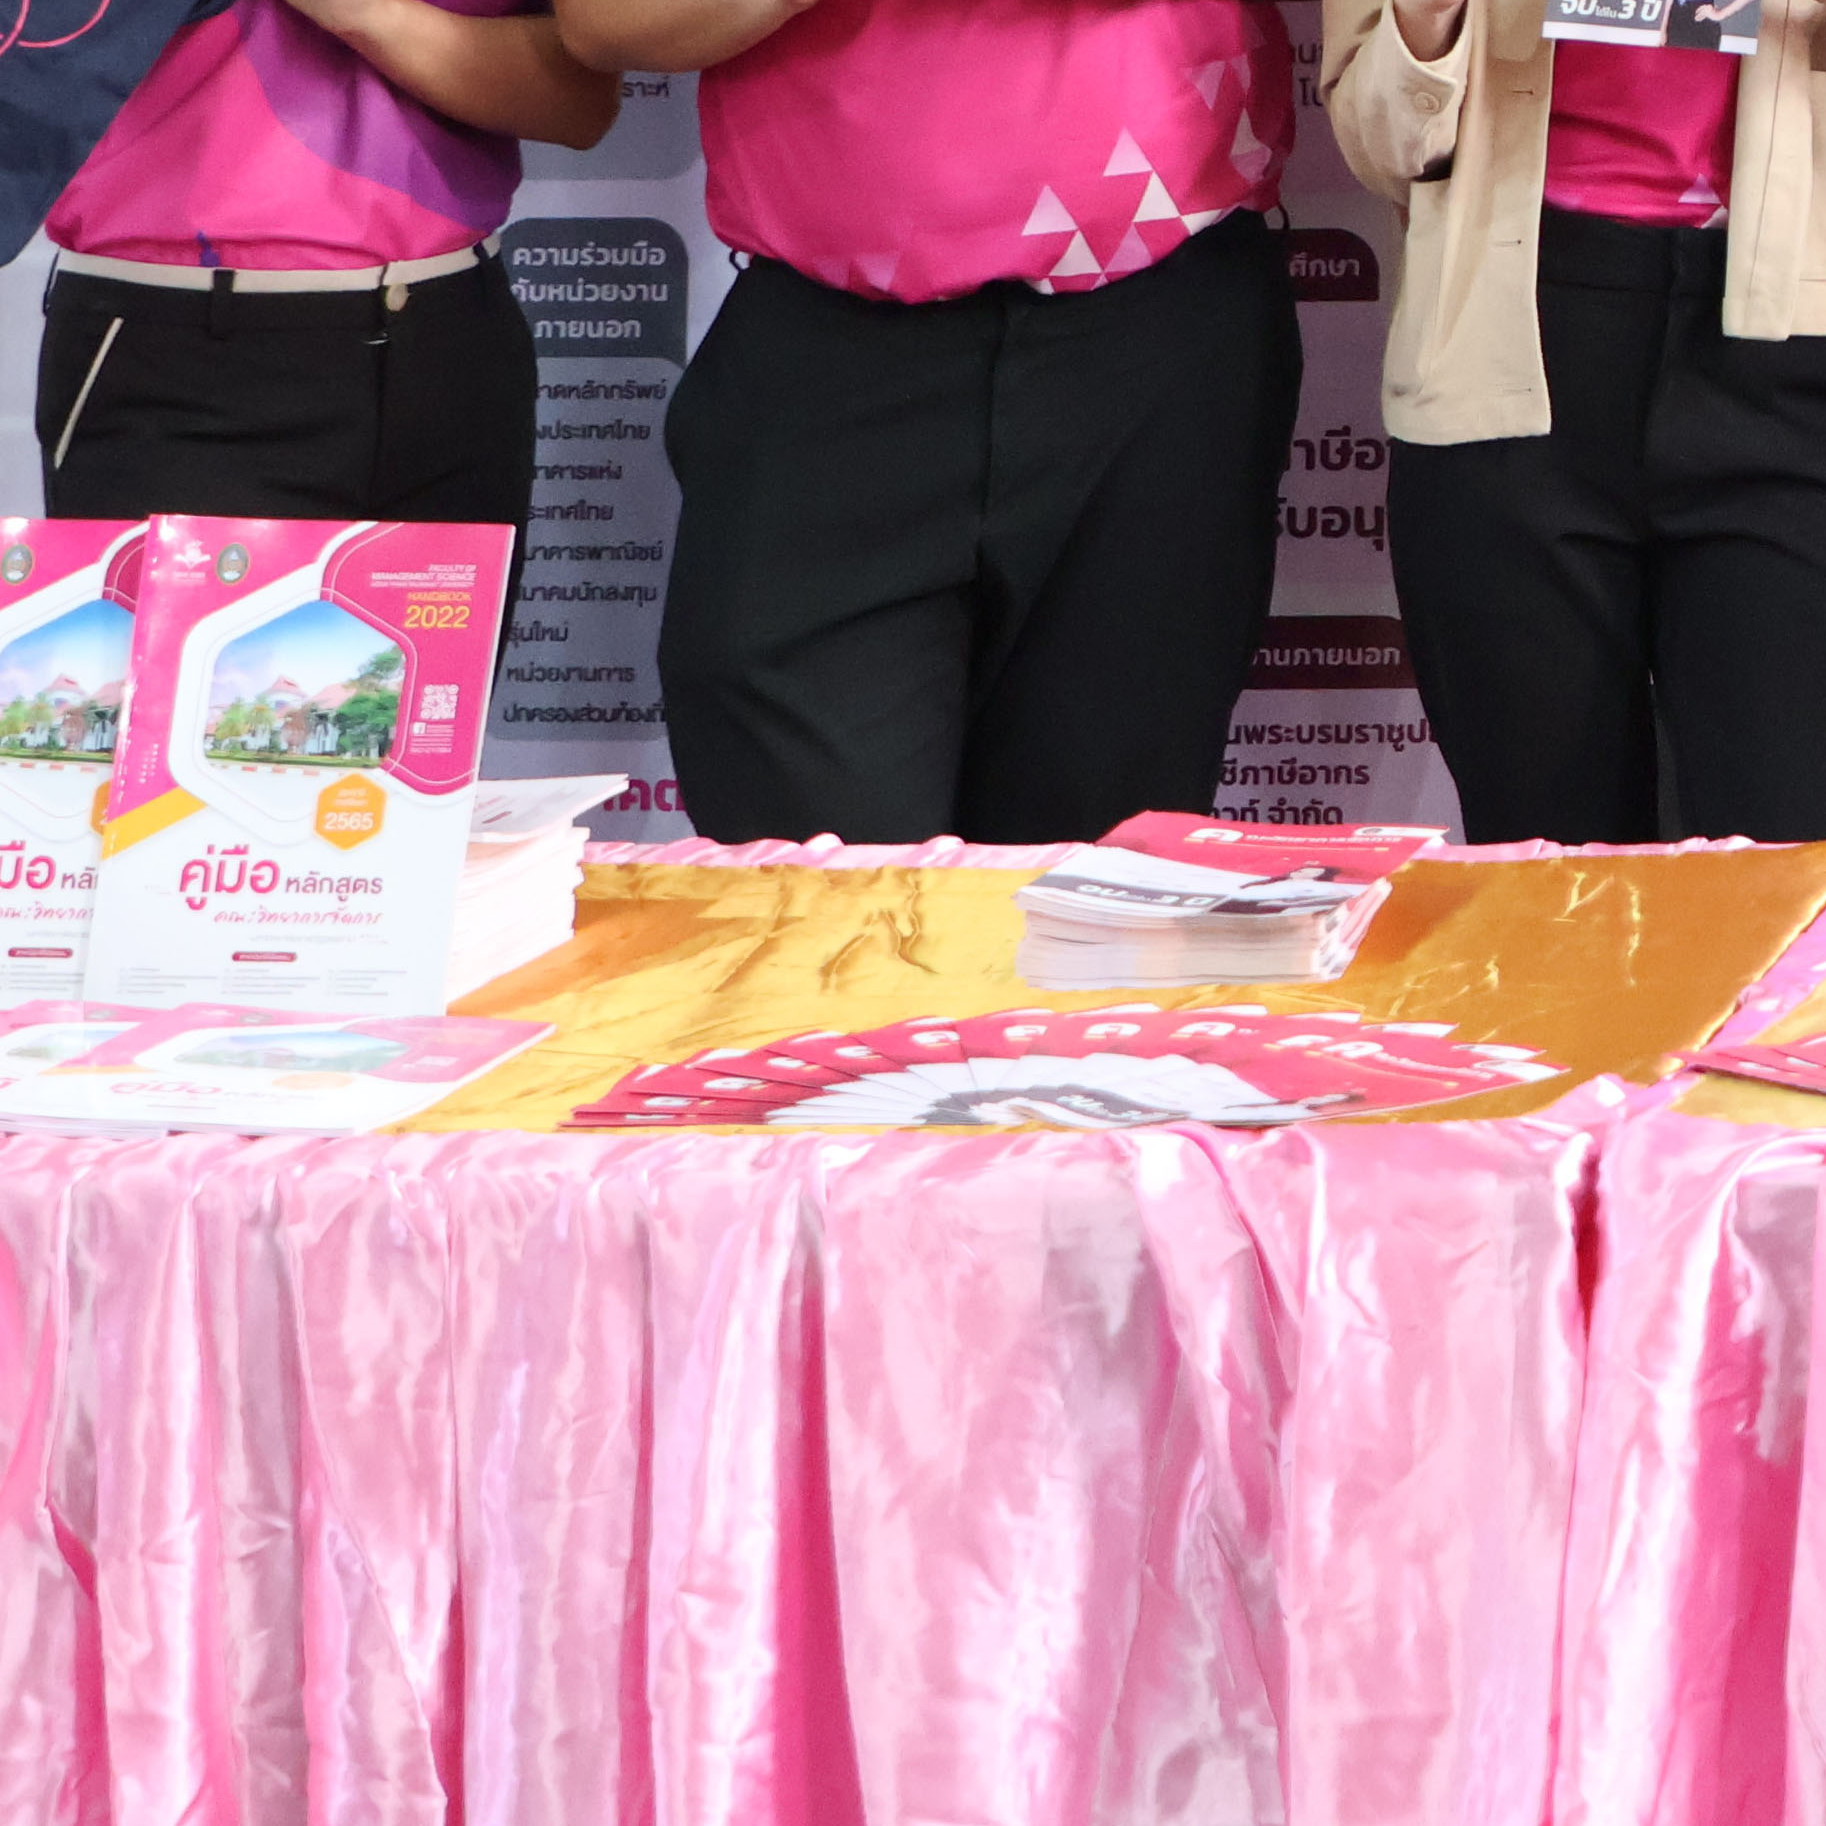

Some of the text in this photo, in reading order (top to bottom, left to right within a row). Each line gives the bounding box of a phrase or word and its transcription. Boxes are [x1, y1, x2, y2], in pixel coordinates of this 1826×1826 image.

[512, 240, 667, 267] ความร่วมมือ
[1289, 252, 1361, 277] ศึกษา
[511, 277, 669, 303] กับหน่วยงาน
[533, 319, 642, 339] ภายนอก
[1293, 425, 1391, 472] าษีอ
[404, 604, 471, 629] 2022
[1226, 718, 1434, 753] พระบรมราชูป
[323, 812, 374, 831] 2565
[178, 843, 384, 911] คู่มือ หลักสูตร
